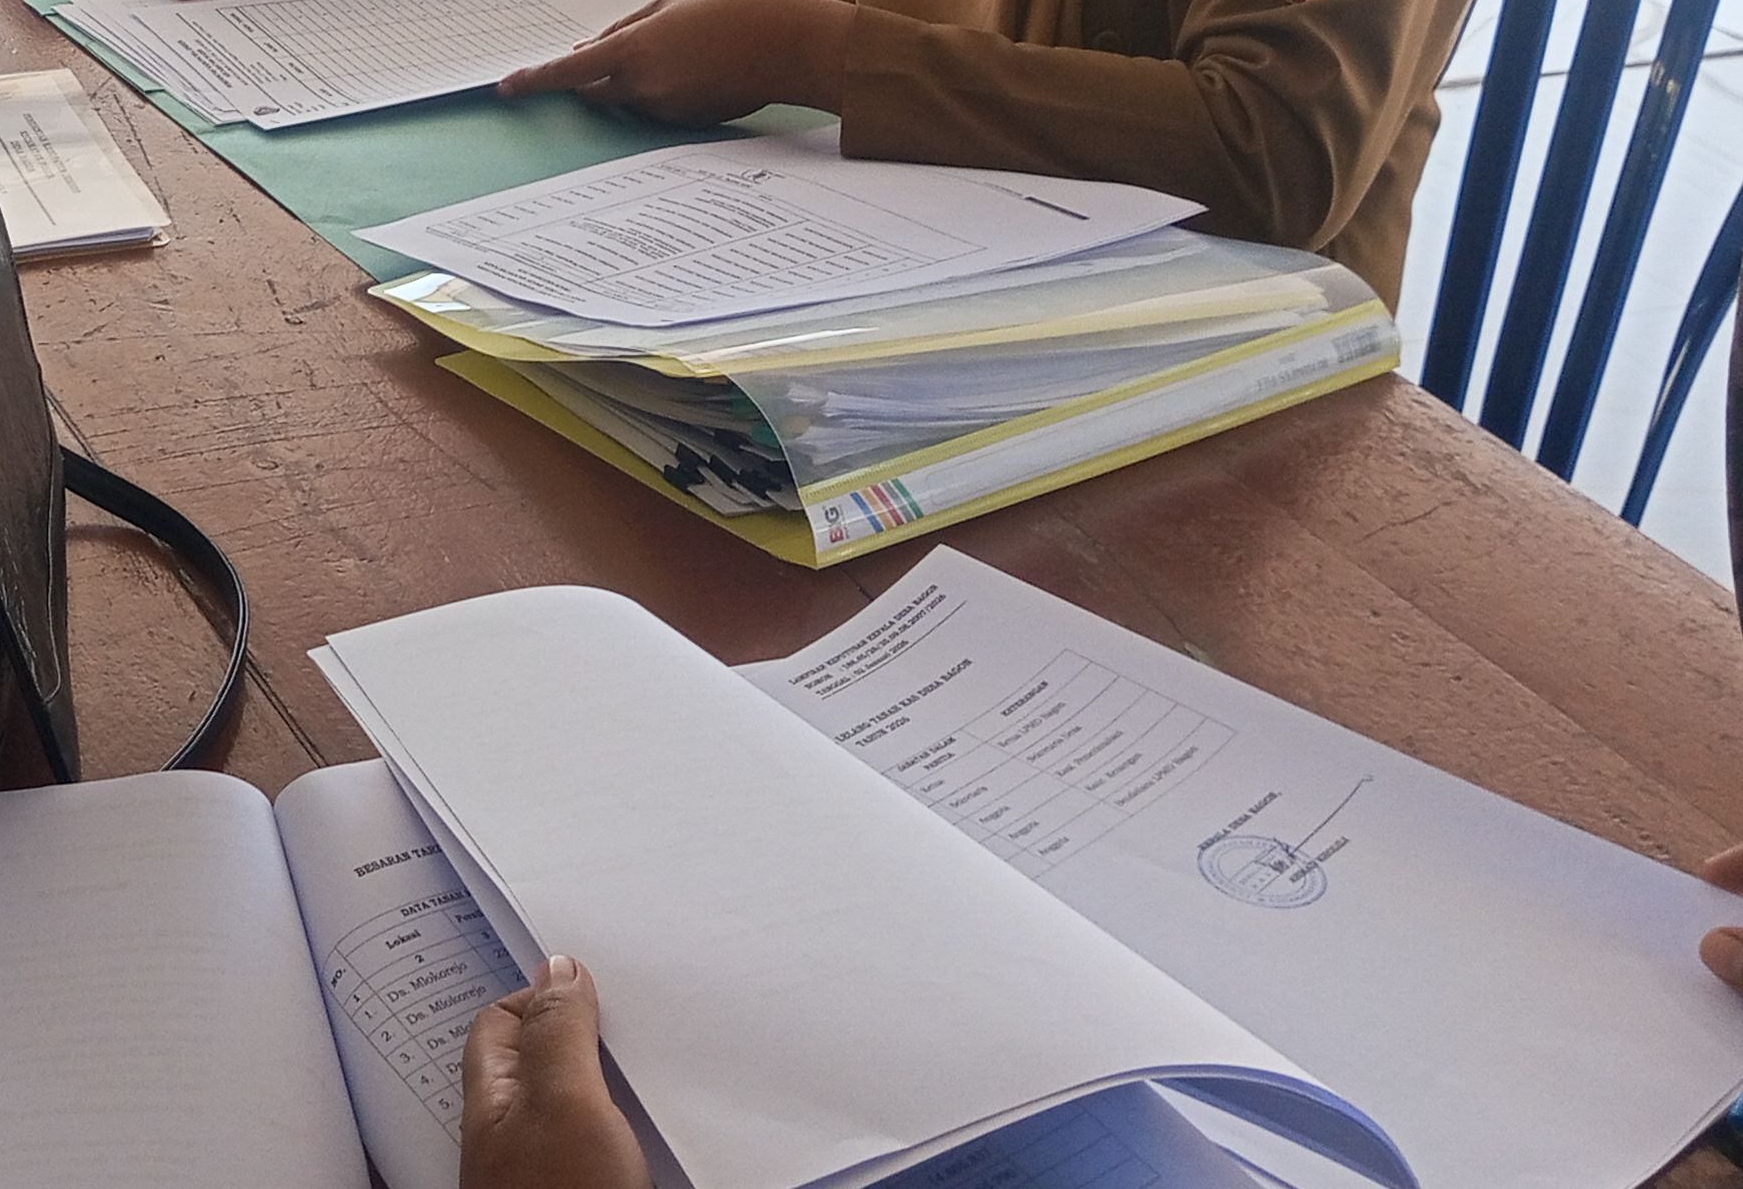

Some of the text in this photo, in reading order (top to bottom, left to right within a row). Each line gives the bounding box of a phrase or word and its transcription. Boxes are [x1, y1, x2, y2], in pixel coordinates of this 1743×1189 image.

[354, 849, 411, 878] BESARAN
[400, 901, 430, 917] DATA
[385, 929, 422, 950] Lokasi
[414, 954, 425, 964] 2
[410, 961, 468, 992] Mlokorejo
[428, 984, 487, 1014] Mlokorejo
